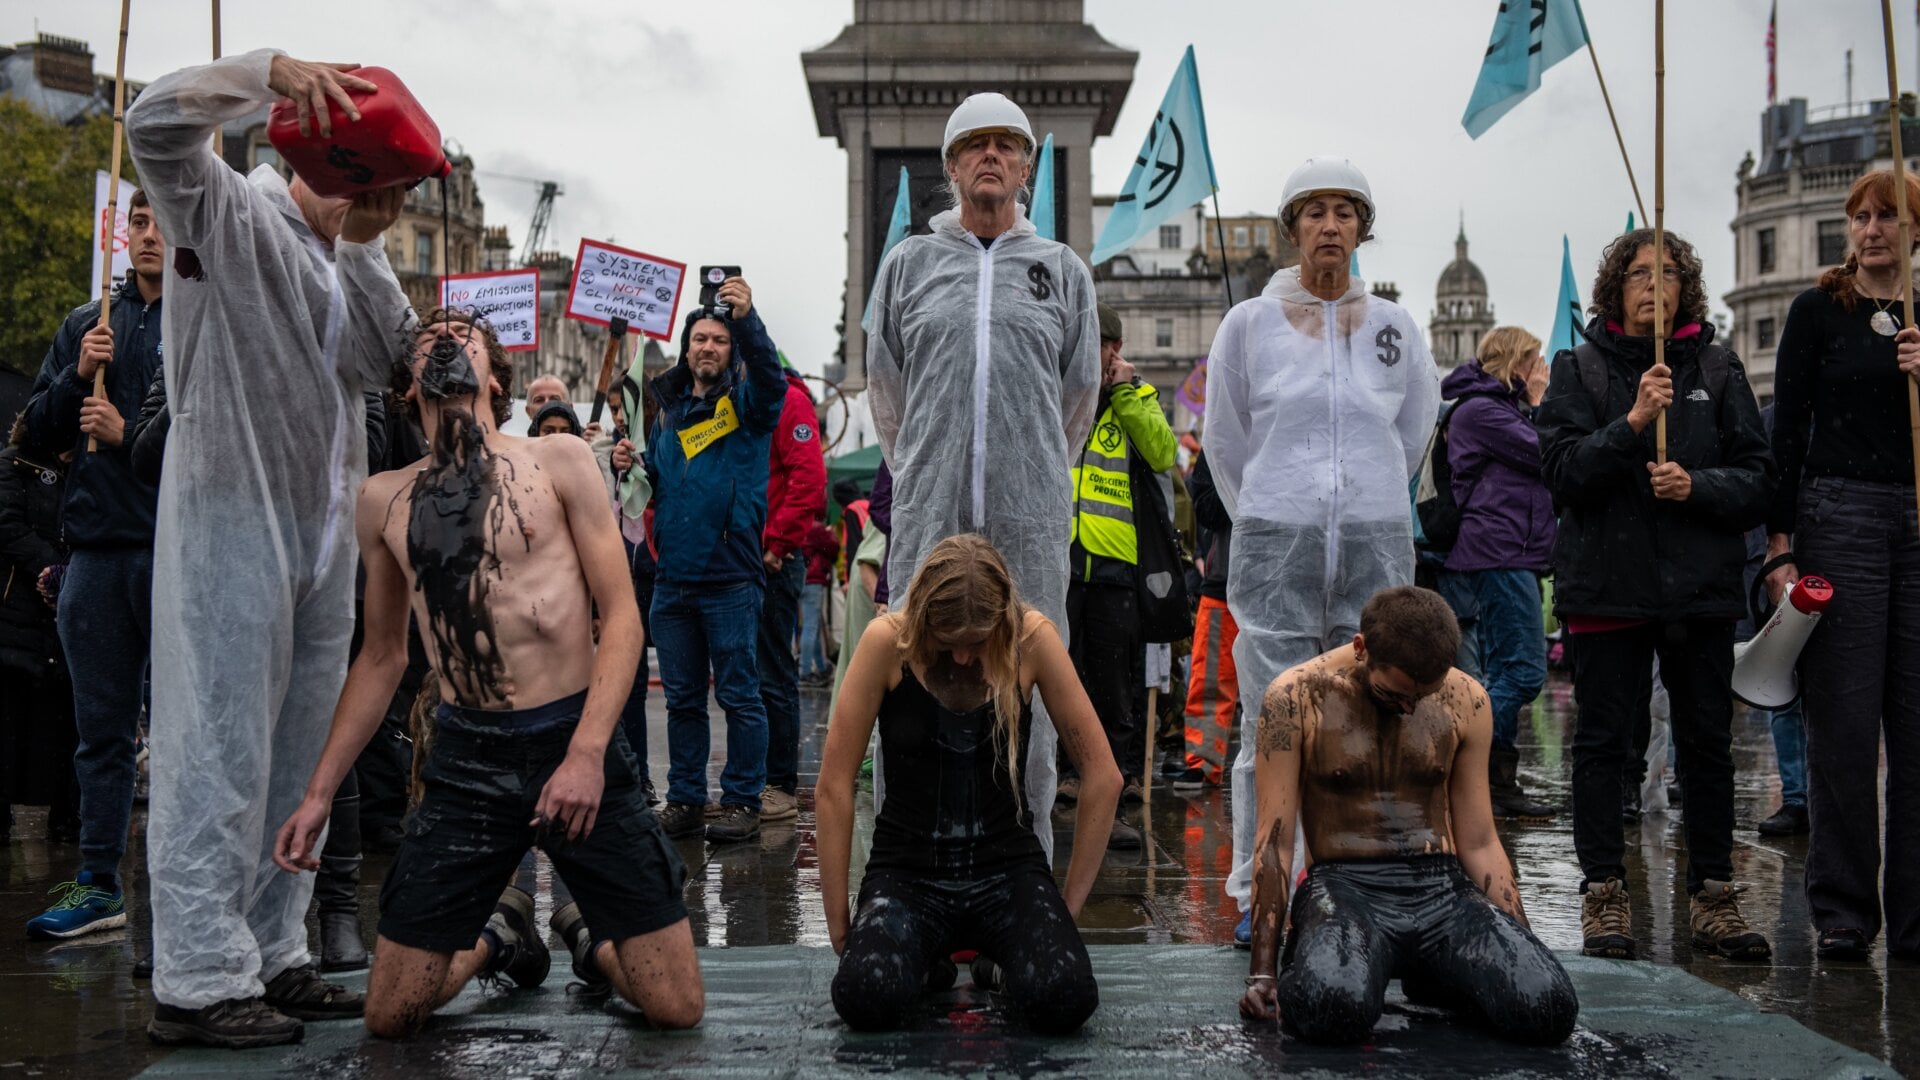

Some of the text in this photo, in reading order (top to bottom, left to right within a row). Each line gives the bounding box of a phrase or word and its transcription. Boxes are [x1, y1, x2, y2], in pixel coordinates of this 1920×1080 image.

[596, 252, 667, 281] SYSTEM
[601, 268, 655, 286] CHANGE
[451, 283, 534, 303] NO EMISSIONS
[613, 283, 646, 297] NOT
[585, 289, 657, 313] CLIMATE
[594, 303, 646, 322] CHANGE
[495, 320, 528, 333] USES
[1375, 324, 1402, 367] $
[1089, 473, 1129, 489] CONSCIENTI
[1093, 485, 1131, 499] PROTECTO
